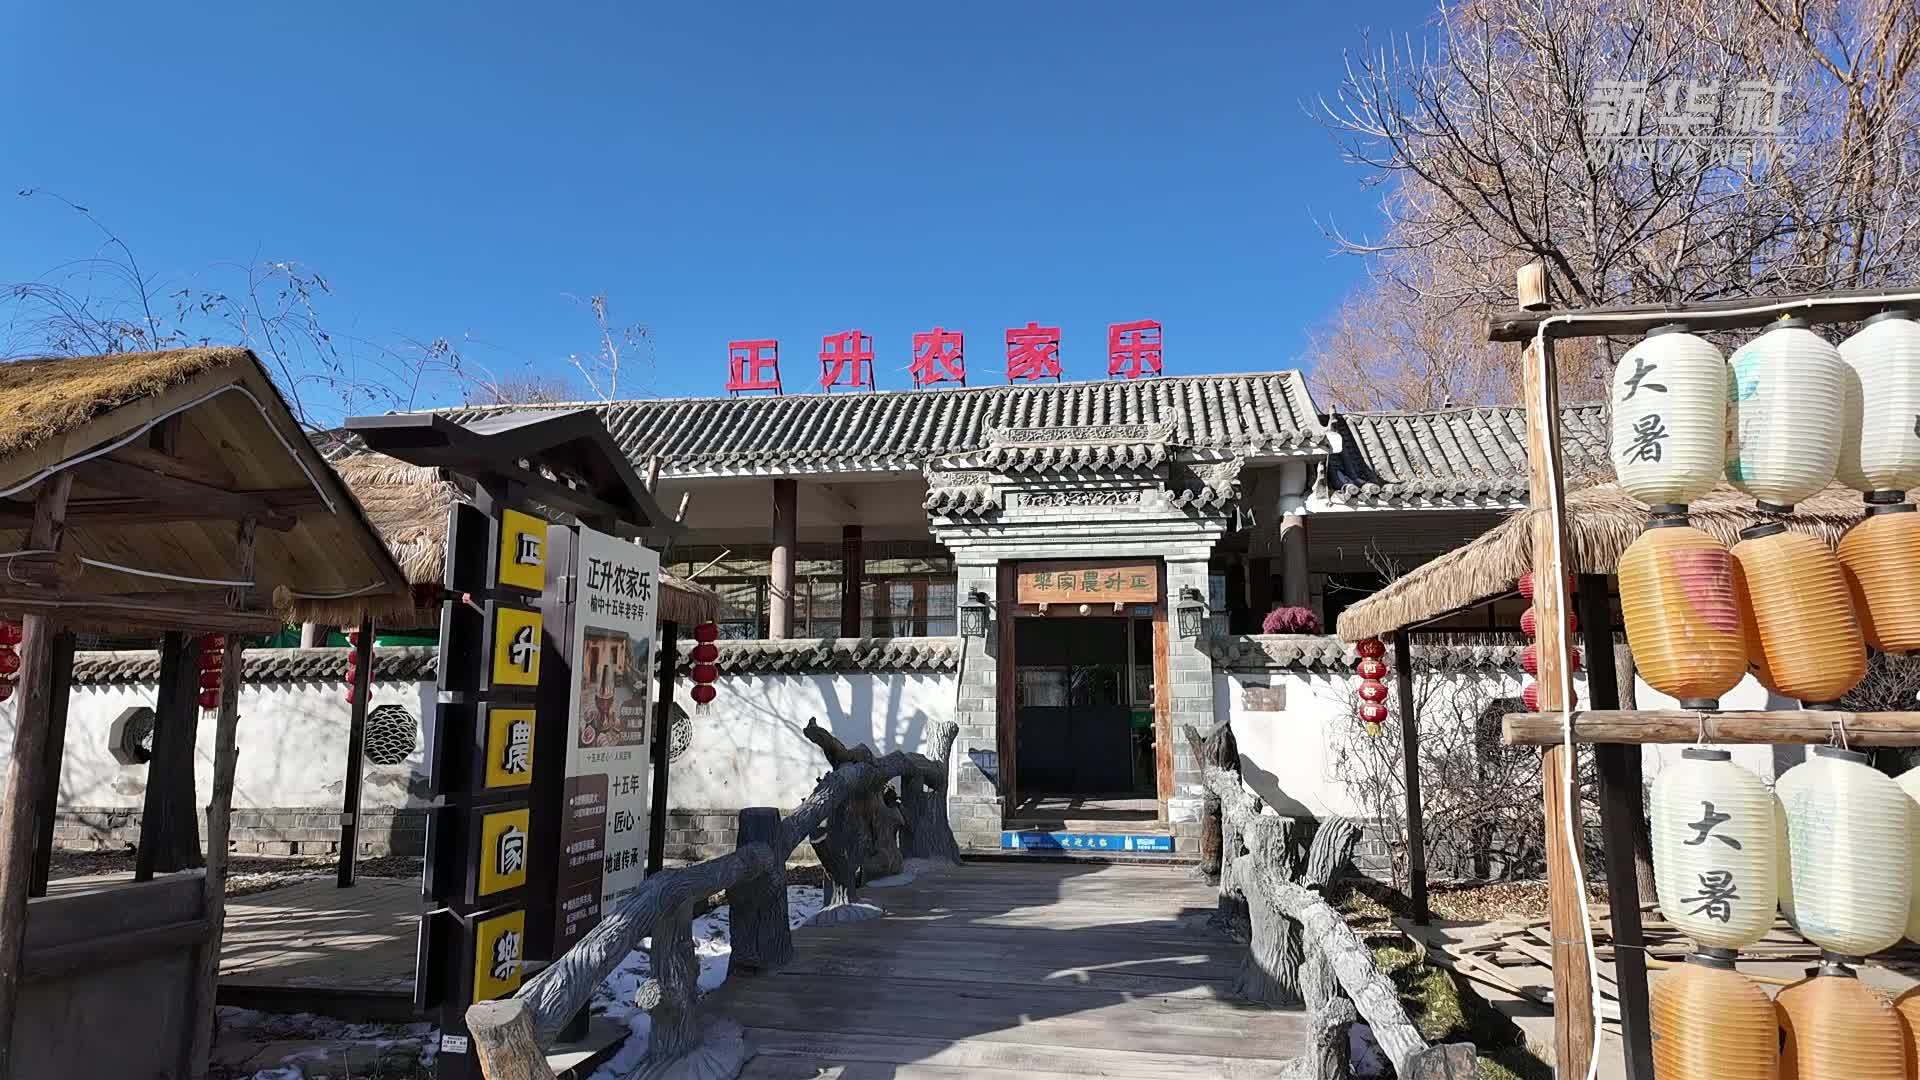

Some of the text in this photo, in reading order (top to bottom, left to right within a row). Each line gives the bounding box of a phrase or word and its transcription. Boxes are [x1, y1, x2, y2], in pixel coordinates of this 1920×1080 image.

[725, 320, 1163, 390] 正升农家乐
[1621, 357, 1670, 465] 大暑
[586, 557, 652, 602] 正升农家乐
[612, 774, 640, 797] 十五年
[604, 847, 640, 874] 地道传承
[1680, 800, 1742, 923] 大暑
